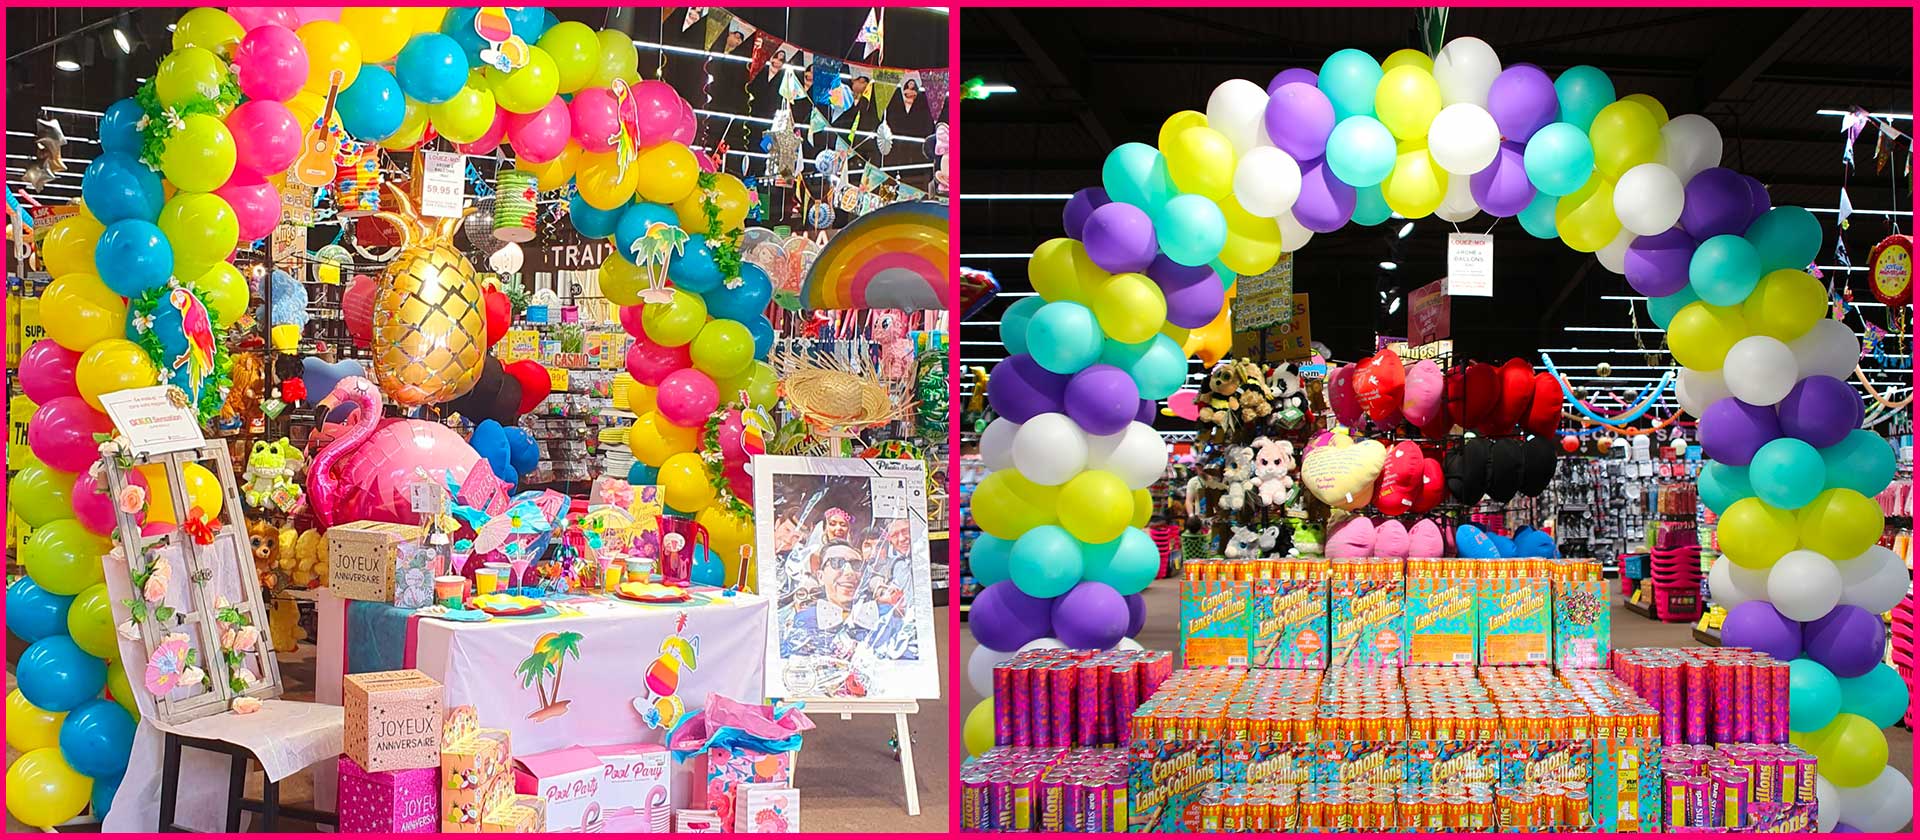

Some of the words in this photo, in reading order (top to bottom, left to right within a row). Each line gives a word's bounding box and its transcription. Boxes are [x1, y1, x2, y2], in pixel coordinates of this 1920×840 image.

[554, 353, 589, 368] CASINO
[336, 554, 380, 572] JOYEUX
[335, 571, 380, 585] ANNIVERSAIRE
[1200, 587, 1233, 612] Canons
[1272, 586, 1309, 615] Canons
[1351, 587, 1387, 616] Canons
[1427, 586, 1460, 610] Canons
[1500, 584, 1532, 610] Canons
[1189, 598, 1246, 634] Lance-Cotillons
[1258, 599, 1322, 638] Lance-Cotillons
[1337, 599, 1401, 639] Lance-Cotillons
[1415, 595, 1472, 631] Lance-Cotillons
[1488, 593, 1545, 631] Lance-Cotillons
[377, 716, 434, 737] JOYEUX
[376, 736, 436, 751] ANNIVERSAIRE
[604, 764, 630, 780] Pool
[632, 762, 664, 780] Party
[1152, 749, 1197, 784] Canons
[1246, 751, 1292, 784] Canons
[1339, 750, 1384, 784] Canons
[1432, 750, 1477, 783] Canons
[1525, 749, 1569, 782] Canons
[546, 783, 571, 801] Pool
[573, 777, 598, 797] Party
[1135, 763, 1214, 813] Lance-Cotillons
